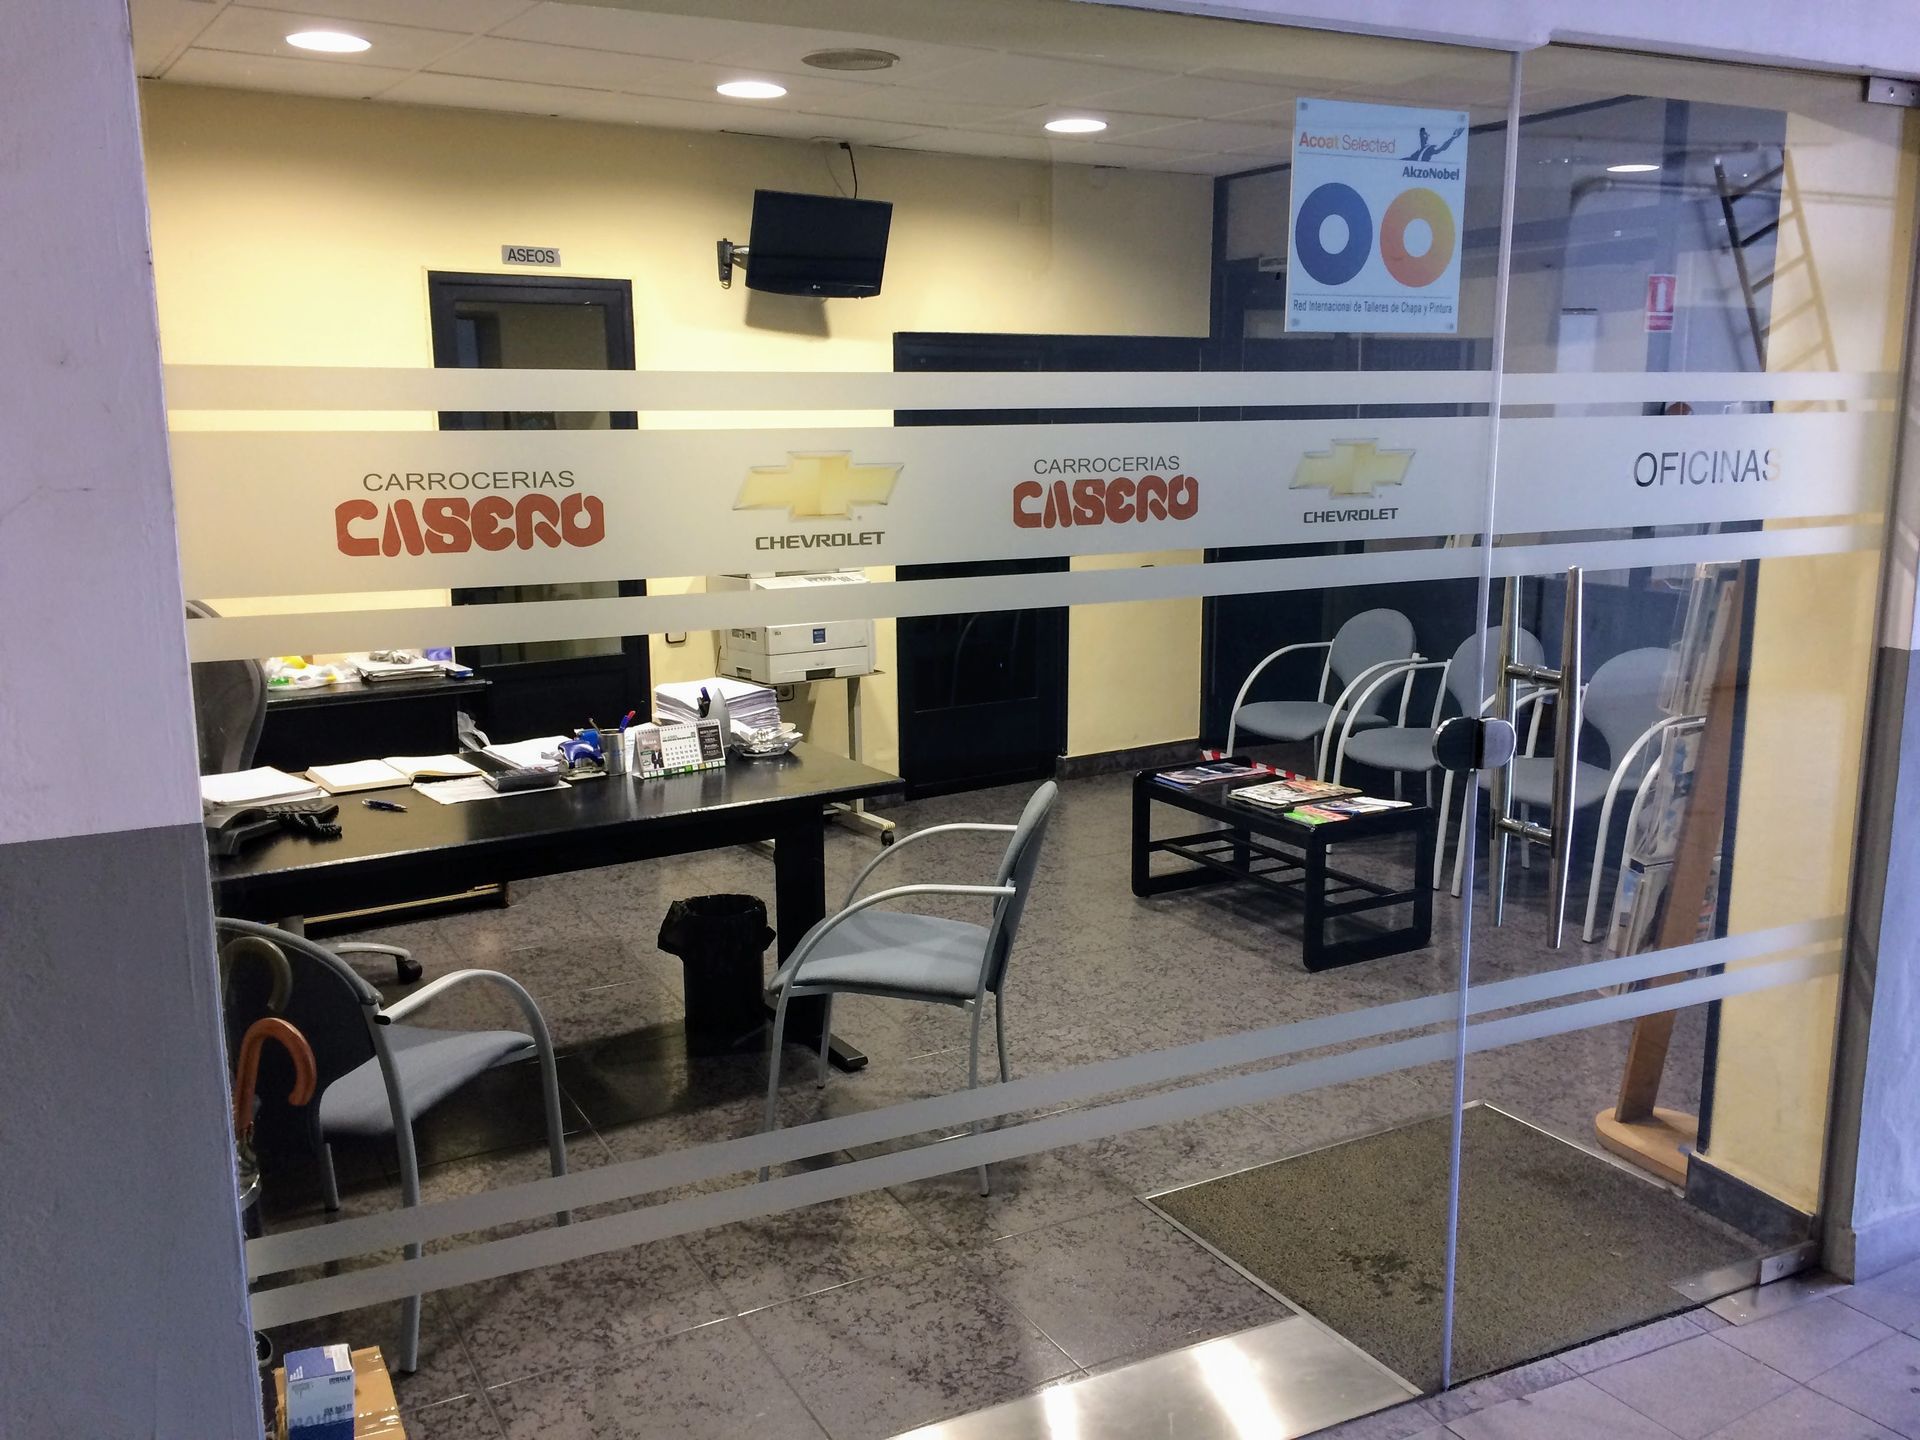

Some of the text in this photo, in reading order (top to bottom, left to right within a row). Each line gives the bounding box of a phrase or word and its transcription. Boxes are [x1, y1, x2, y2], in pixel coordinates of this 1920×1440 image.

[1299, 131, 1396, 154] Acoat Selected
[1402, 166, 1460, 181] AkzoNobel
[507, 248, 555, 263] ASEOS
[1353, 301, 1362, 312] de
[1391, 302, 1400, 313] de
[1401, 301, 1422, 315] Chapa
[1034, 456, 1180, 474] CARROCERIAS
[1633, 449, 1781, 487] OFICINAS
[363, 470, 575, 491] CARROCERIAS
[1013, 474, 1198, 528] CASERO
[1303, 507, 1399, 523] CHEVROLET
[335, 493, 605, 557] CASERO
[755, 531, 885, 550] CHEVROLET
